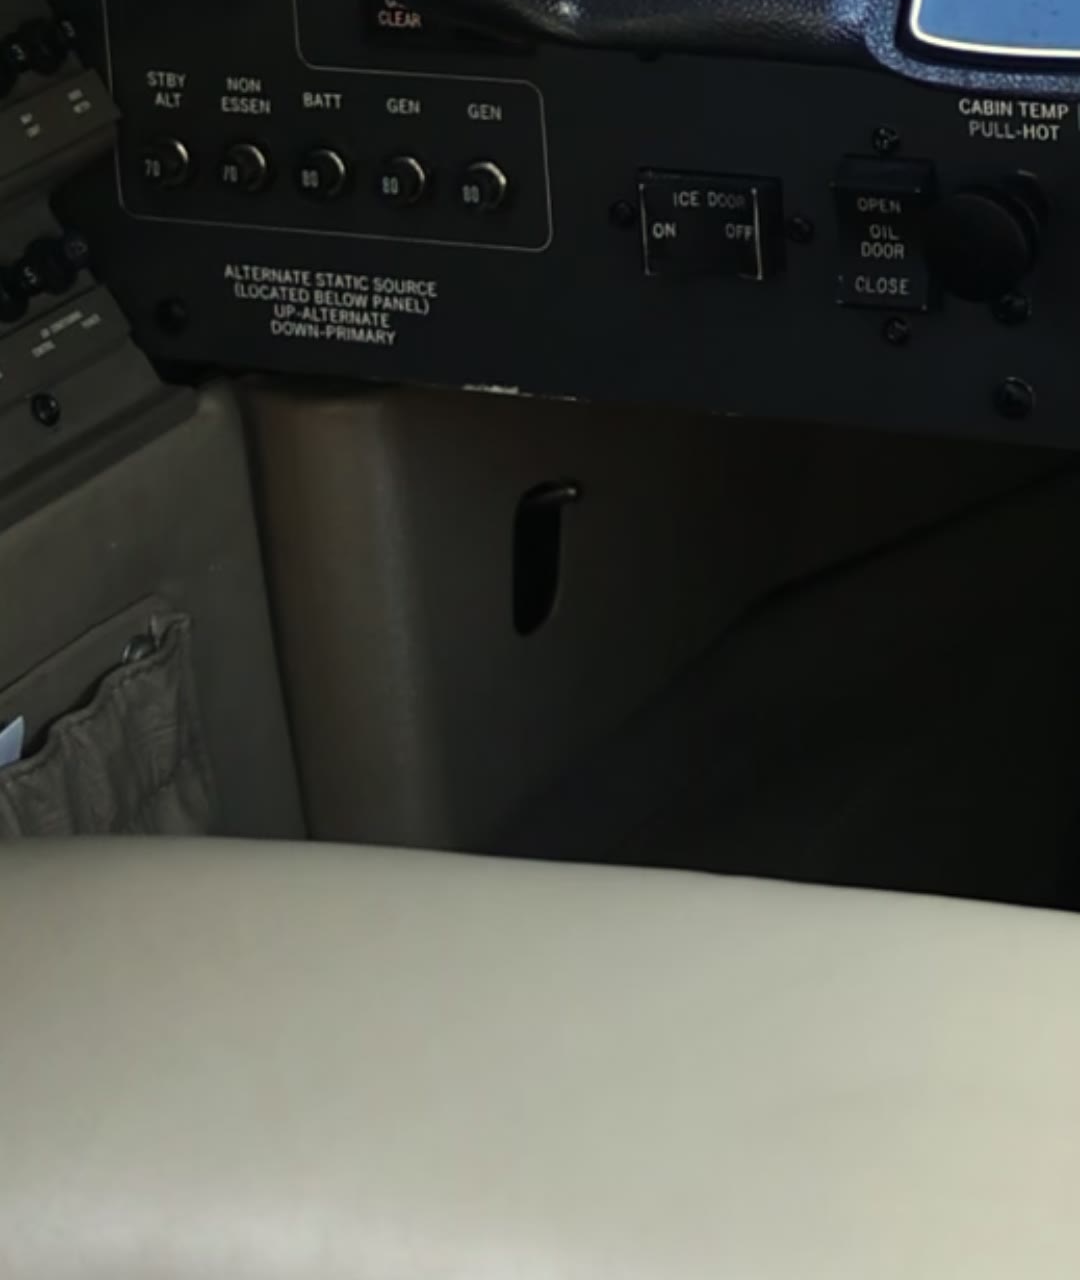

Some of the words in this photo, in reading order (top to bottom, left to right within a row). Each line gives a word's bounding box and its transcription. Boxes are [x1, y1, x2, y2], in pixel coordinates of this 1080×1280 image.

[147, 71, 186, 88] STBY
[227, 79, 261, 92] NON
[155, 92, 181, 108] ALT
[221, 96, 271, 114] ESSEN
[303, 92, 343, 109] BATT
[387, 99, 420, 114] GEN
[468, 104, 502, 120] GEN
[959, 99, 1013, 116] CABIN
[1017, 102, 1069, 121] TEMP
[969, 121, 1060, 141] PULL-HOT
[673, 192, 700, 208] ICE
[857, 198, 901, 214] OPEN
[653, 223, 677, 238] ON
[869, 225, 899, 240] OIL
[861, 242, 904, 259] DOOR
[224, 264, 313, 287] ALTERNATE
[316, 273, 369, 292] STATIC
[372, 280, 437, 298] SOURCE
[855, 278, 910, 295] CLOSE
[234, 283, 310, 303] (LOCATED
[314, 290, 369, 308] BELOW
[372, 295, 430, 316] PANEL)
[274, 305, 390, 328] UP-ALTERNATE
[270, 320, 396, 345] DOWN-PRIMARY
